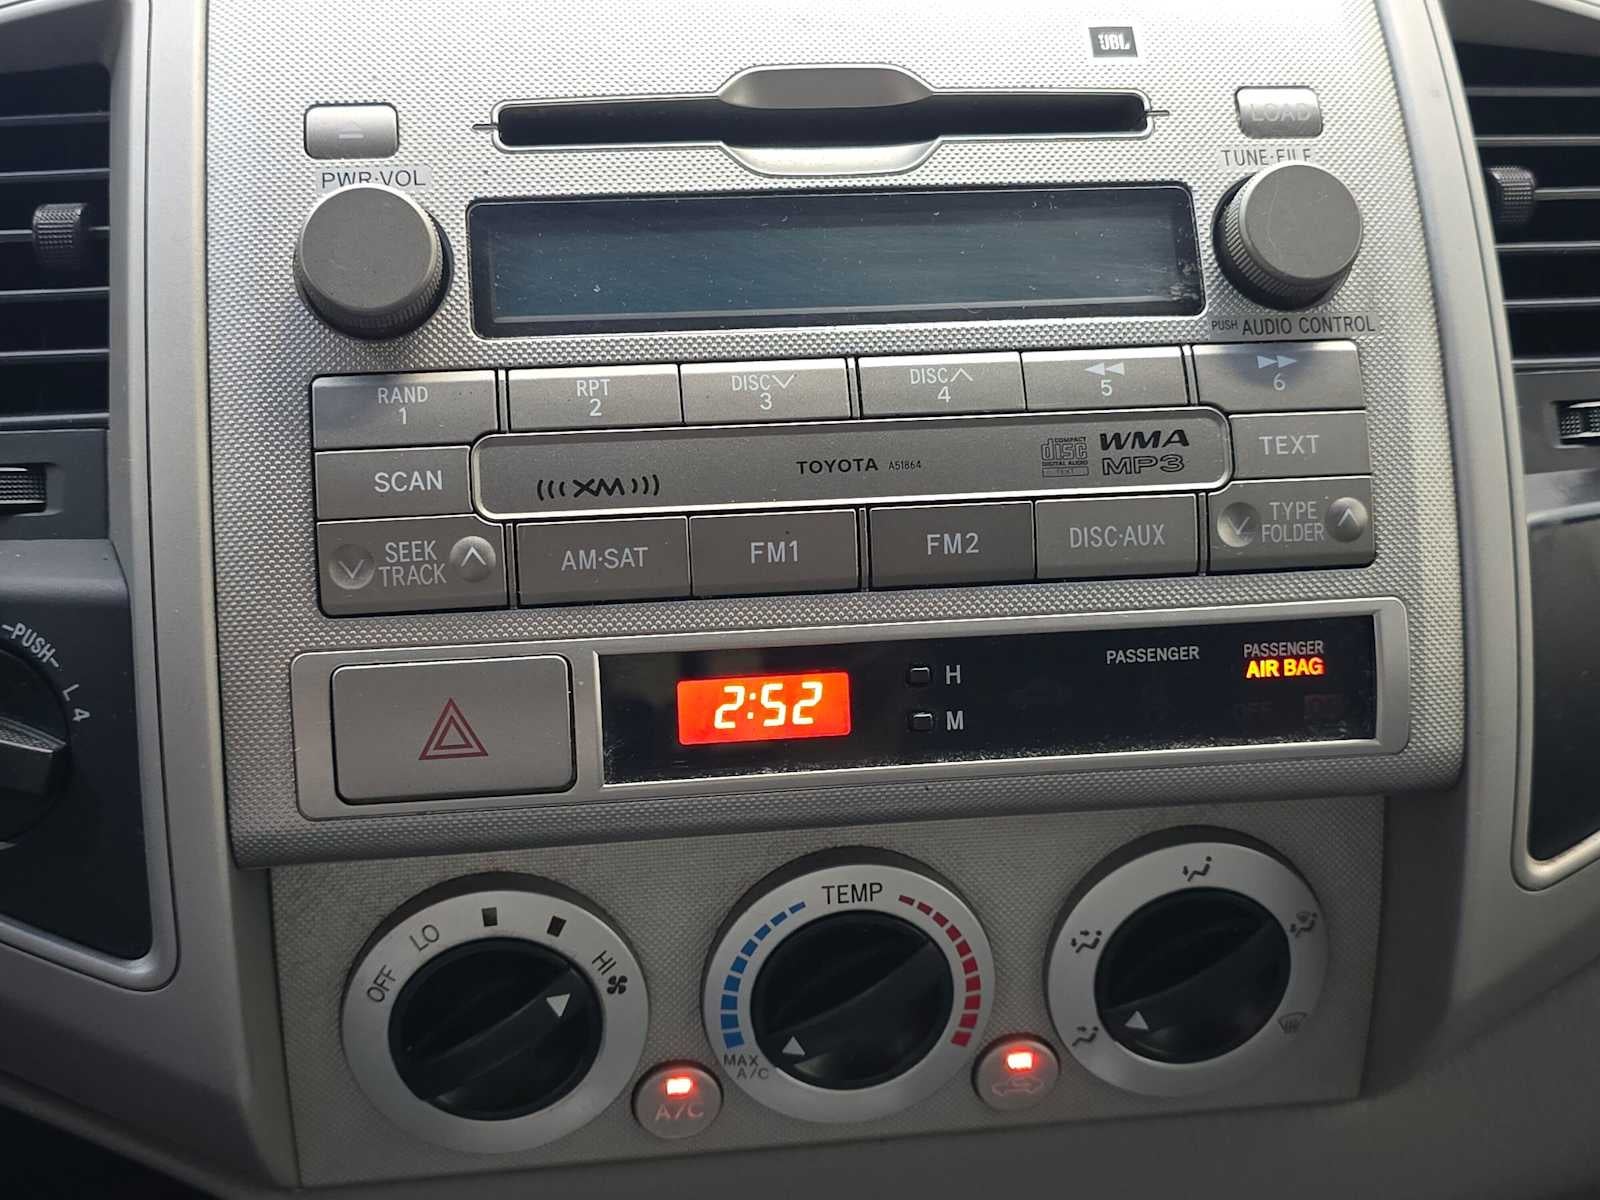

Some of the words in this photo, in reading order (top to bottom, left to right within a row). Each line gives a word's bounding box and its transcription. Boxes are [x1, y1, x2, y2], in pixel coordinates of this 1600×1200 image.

[1098, 33, 1130, 50] JBL
[1250, 103, 1311, 121] LOAD
[1211, 320, 1239, 331] PUSH
[1242, 317, 1292, 335] AUDIO
[1299, 315, 1376, 333] CONTROL
[731, 374, 771, 392] DISC
[910, 367, 949, 385] DISC
[1273, 373, 1286, 391] 6
[377, 386, 429, 404] RAND
[576, 379, 610, 397] RPT
[938, 386, 952, 402] 4
[1101, 379, 1113, 397] 5
[589, 400, 602, 417] 2
[759, 393, 773, 410] 3
[399, 408, 407, 425] 1
[1100, 429, 1190, 451] WMA
[1259, 435, 1320, 455] TEXT
[796, 458, 879, 475] TOYOTA
[1102, 454, 1185, 476] MP3
[374, 470, 443, 493] SCAN
[1270, 501, 1317, 520] TYPE
[1261, 523, 1325, 544] FOLDER
[385, 540, 438, 562] SEEK
[750, 541, 799, 565] FM1
[927, 533, 980, 556] FM2
[379, 563, 447, 588] TRACK
[1106, 646, 1200, 664] PASSENGER
[1243, 640, 1324, 658] PASSENGER
[945, 664, 961, 685] H
[1246, 659, 1280, 678] AIR
[1283, 657, 1325, 677] BAG
[713, 681, 823, 730] 2:52
[946, 711, 964, 731] M
[822, 882, 884, 905] TEMP
[409, 924, 440, 952] LO
[591, 950, 617, 975] HI
[366, 965, 397, 1004] OFF
[723, 1054, 759, 1067] MAX
[736, 1066, 769, 1081] A/C
[654, 1101, 704, 1122] A/C
